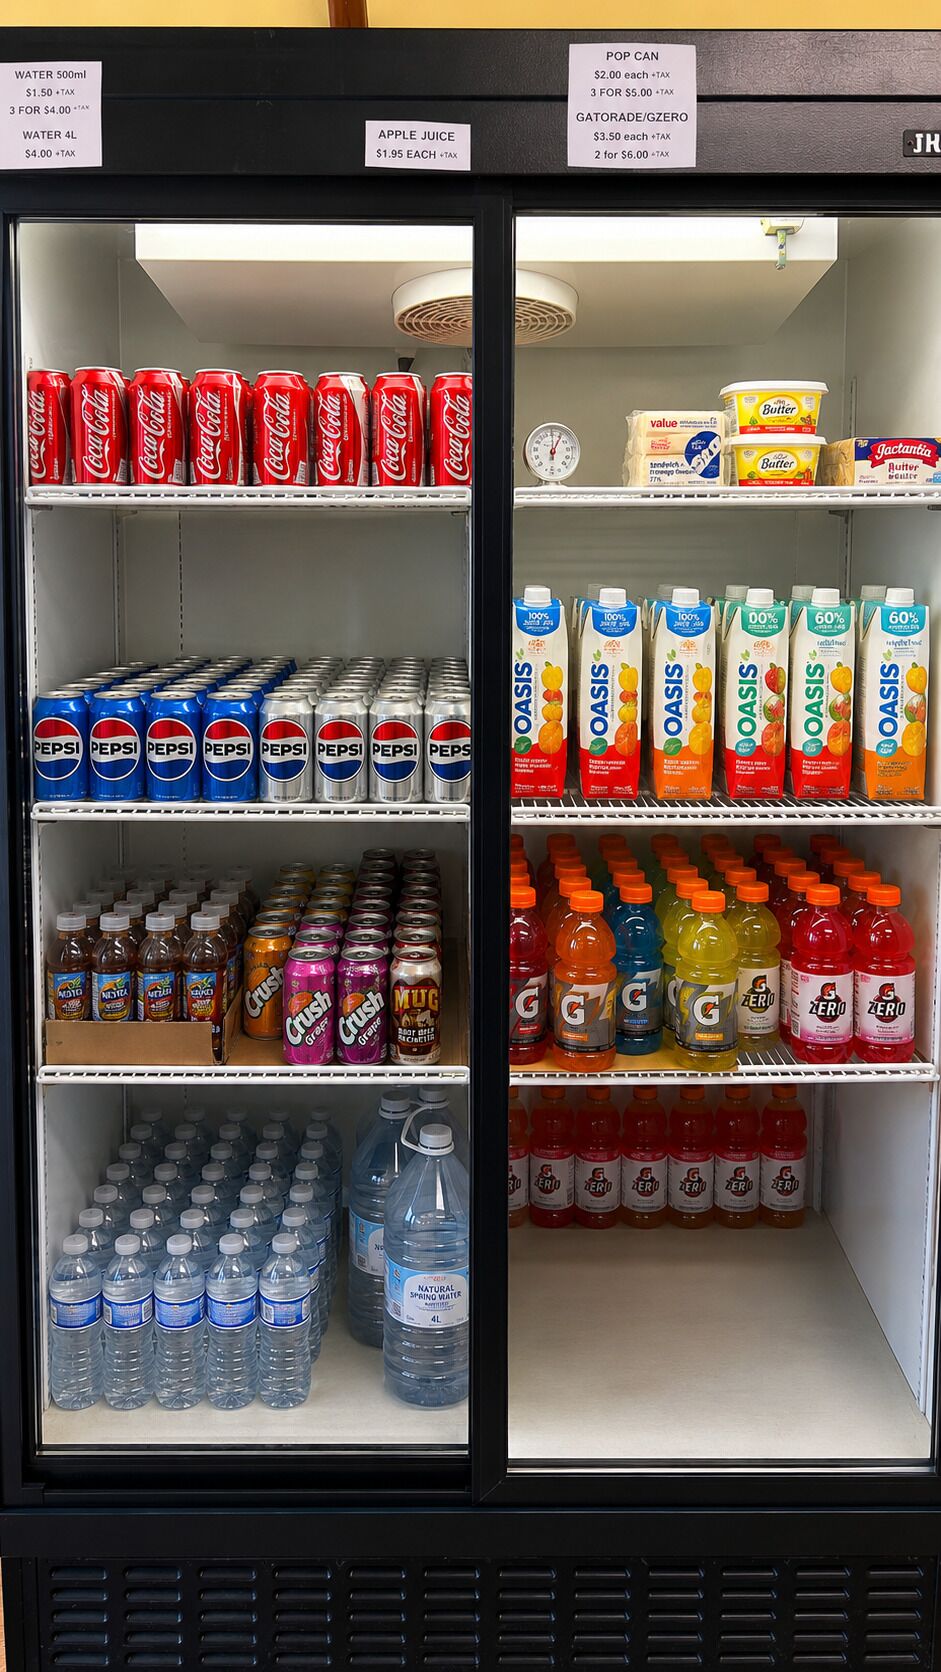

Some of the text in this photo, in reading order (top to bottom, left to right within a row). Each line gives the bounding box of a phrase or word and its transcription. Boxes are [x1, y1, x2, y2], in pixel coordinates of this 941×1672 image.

[606, 51, 659, 61] POP CAN
[15, 70, 86, 79] WATER 500ml
[594, 70, 621, 80] $2.00
[624, 71, 649, 79] each
[26, 88, 52, 97] $1.50
[590, 88, 596, 97] 3
[600, 88, 622, 97] FOR
[625, 88, 652, 97] $5.00
[10, 106, 15, 115] 3
[19, 106, 40, 114] FOR
[44, 106, 71, 115] $4.00
[576, 112, 688, 122] GATORADE/GZERO
[23, 131, 77, 139] WATER 4L
[378, 130, 455, 141] APPLE JUICE
[594, 132, 621, 141] $3.50
[624, 132, 648, 141] each
[25, 149, 52, 158] $4.00
[376, 148, 403, 158] $1.95
[407, 150, 436, 159] EACH
[594, 150, 600, 159] 2
[604, 150, 618, 159] for
[622, 150, 649, 160] $6.00
[762, 404, 796, 415] Butter
[650, 418, 677, 428] value
[761, 458, 794, 469] Butter
[815, 612, 845, 624] 60%
[889, 611, 919, 624] 60%
[514, 662, 533, 734] OASIS
[590, 663, 609, 736] OASIS
[664, 663, 684, 736] OASIS
[737, 663, 758, 737] OASIS
[804, 663, 824, 737] OASIS
[878, 663, 899, 737] OASIS
[35, 742, 79, 755] PEPSI
[91, 742, 137, 755] PEPSI
[148, 742, 193, 756] PEPSI
[205, 743, 250, 756] PEPSI
[262, 743, 306, 756] PEPSI
[318, 743, 362, 757] PEPSI
[373, 744, 417, 757] PEPSI
[430, 744, 471, 757] PEPS
[246, 967, 284, 1017] Crush
[622, 982, 647, 1012] G
[394, 989, 438, 1012] MUG
[516, 987, 539, 1019] G
[741, 994, 775, 1007] ZERO
[561, 995, 585, 1026] G
[694, 996, 720, 1026] G
[808, 1001, 846, 1016] ZERO
[868, 1001, 906, 1016] ZERO
[286, 991, 332, 1045] Crush
[339, 992, 385, 1045] Crush
[584, 1182, 612, 1192] ZERO
[632, 1181, 660, 1192] ZERO
[679, 1182, 706, 1192] ZERO
[725, 1181, 752, 1192] ZERO
[772, 1180, 799, 1191] ZERO
[418, 1284, 454, 1293] NATURAL
[438, 1291, 461, 1301] WATER
[431, 1315, 441, 1323] 4L
